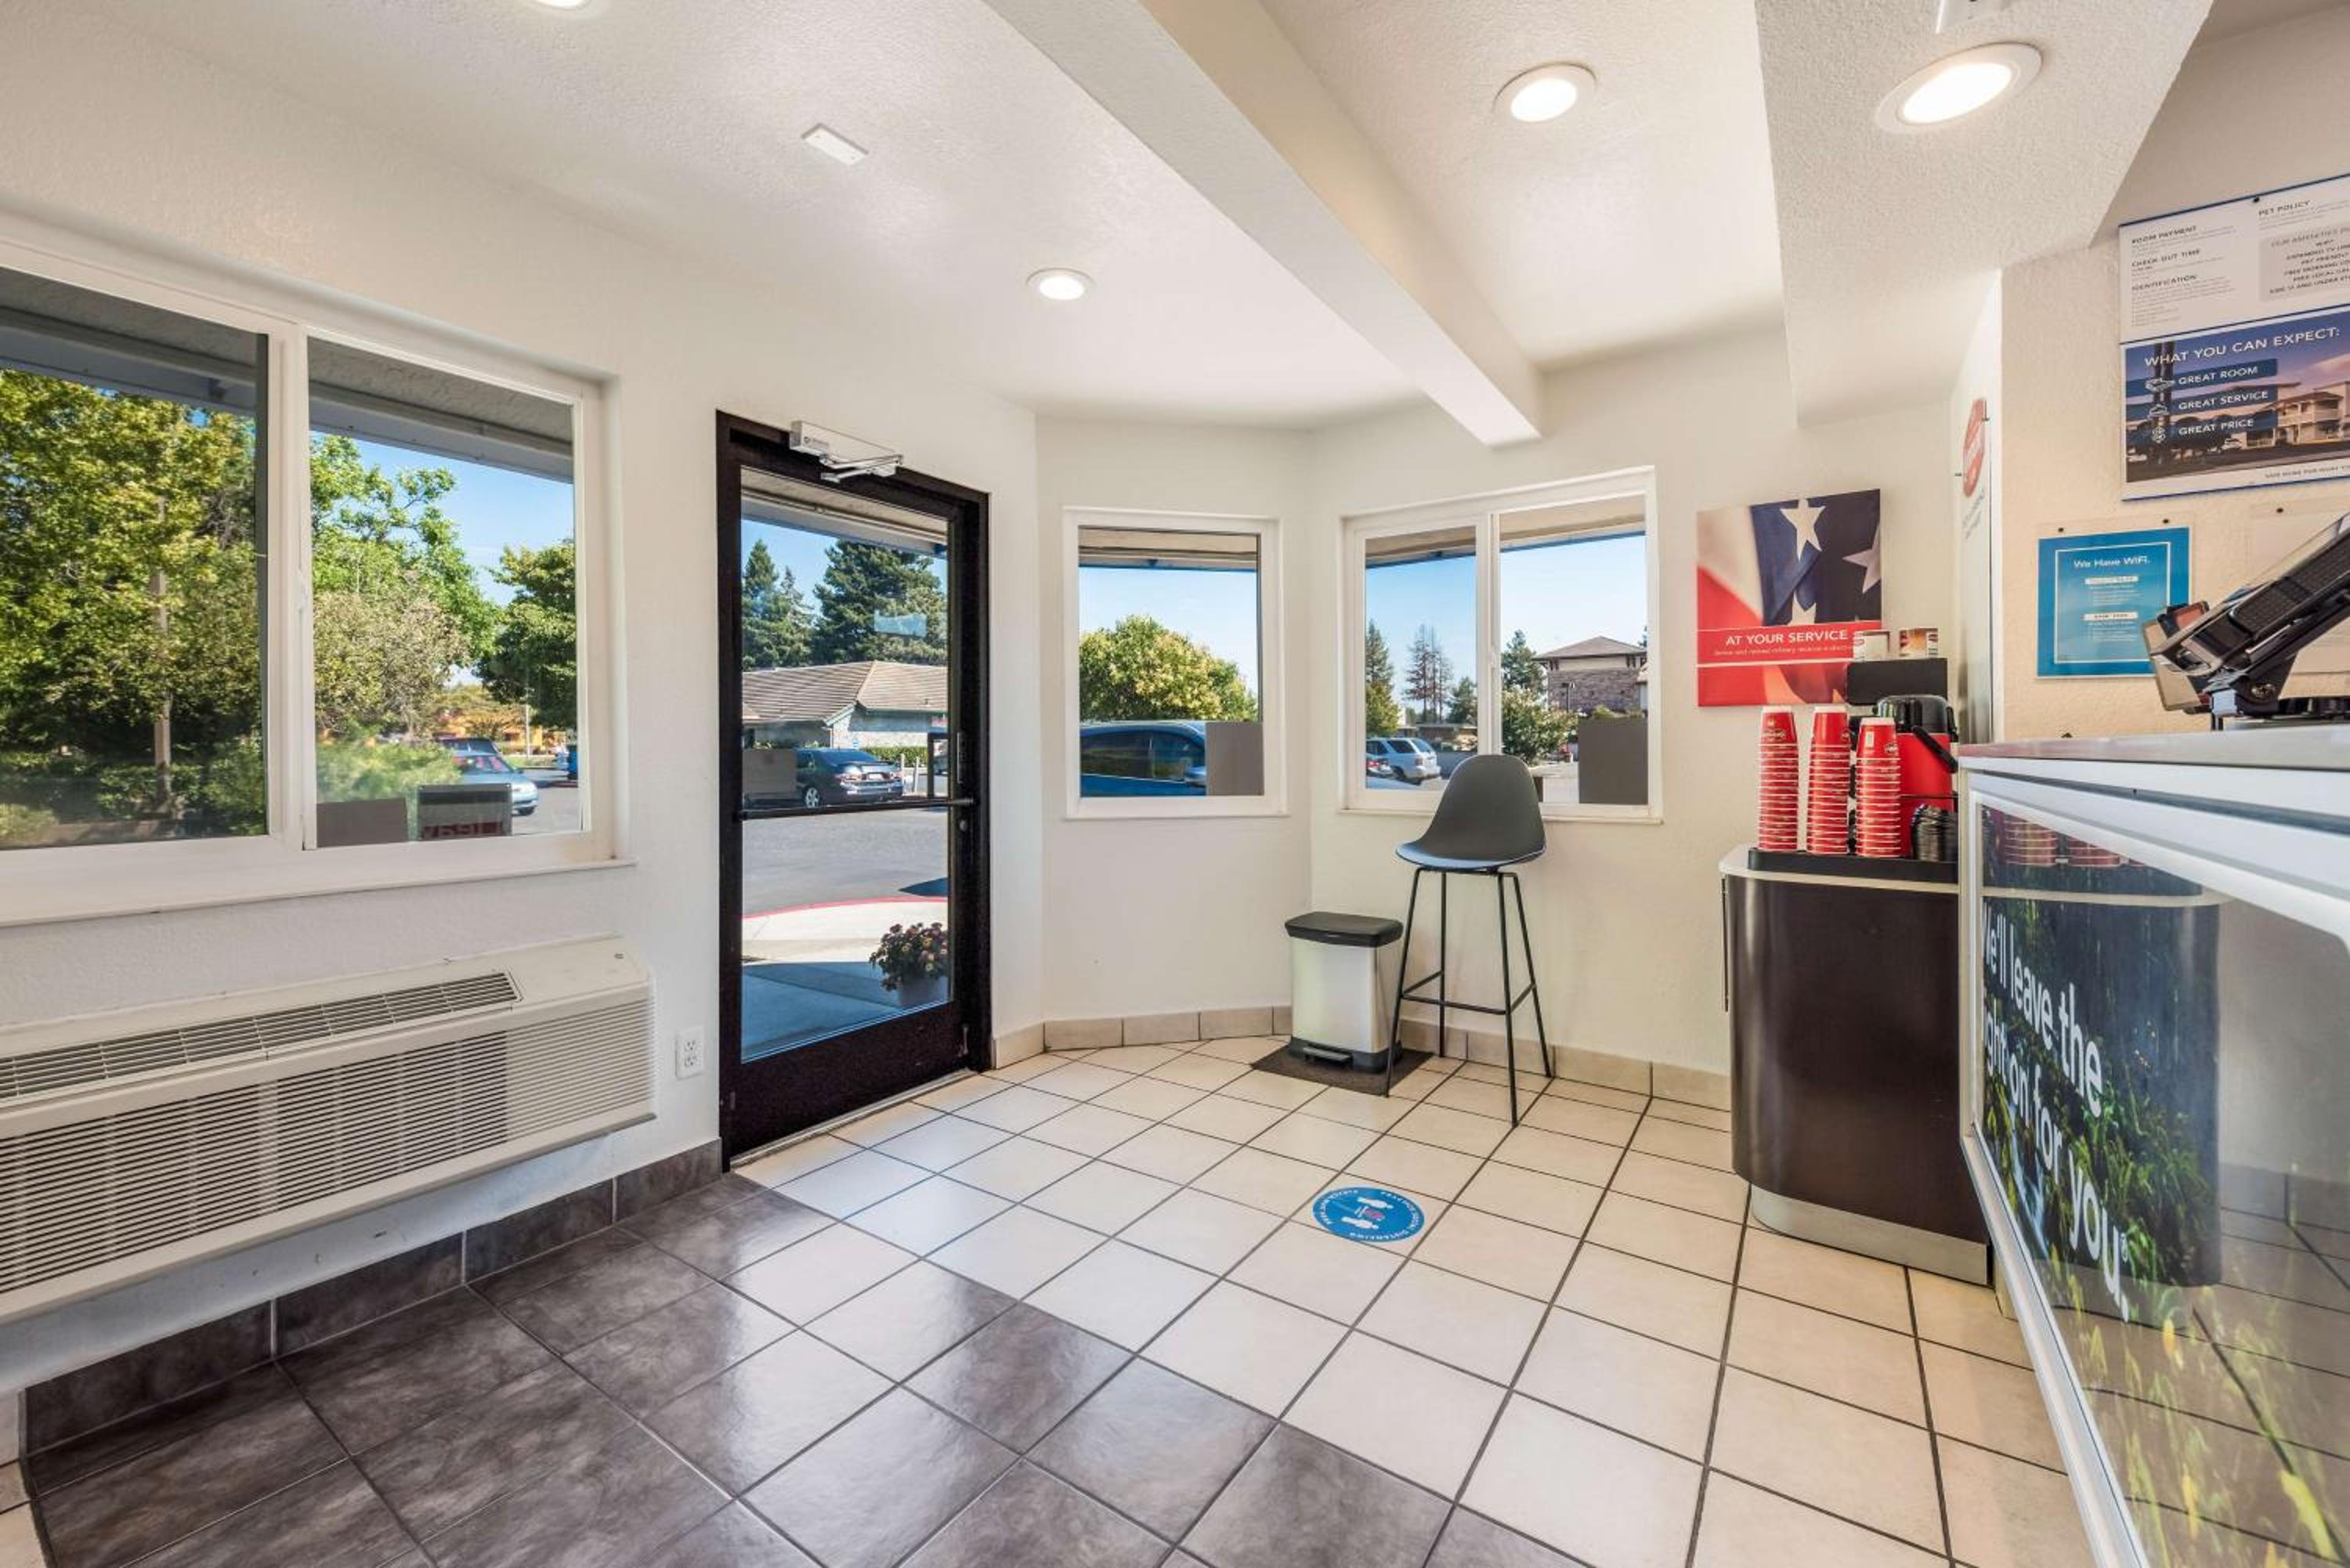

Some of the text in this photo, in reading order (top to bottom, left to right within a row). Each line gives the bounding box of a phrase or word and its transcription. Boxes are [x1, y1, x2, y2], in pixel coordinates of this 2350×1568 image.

[2277, 200, 2310, 212] POLICY
[2144, 326, 2341, 367] WHAT YOU CAN EXPECT:
[2178, 366, 2258, 385] GREAT ROOM
[2178, 390, 2269, 410] GREAT SERVICE
[2178, 418, 2254, 436] GREAT PRICE
[2073, 559, 2092, 569] We
[2094, 558, 2120, 568] Have
[1726, 629, 1849, 646] AT YOUR SERVICE
[2009, 923, 2055, 1051] leave
[2058, 981, 2104, 1118] the
[1985, 996, 2008, 1086] ght
[2009, 1052, 2030, 1129] on
[2033, 1063, 2063, 1186] for
